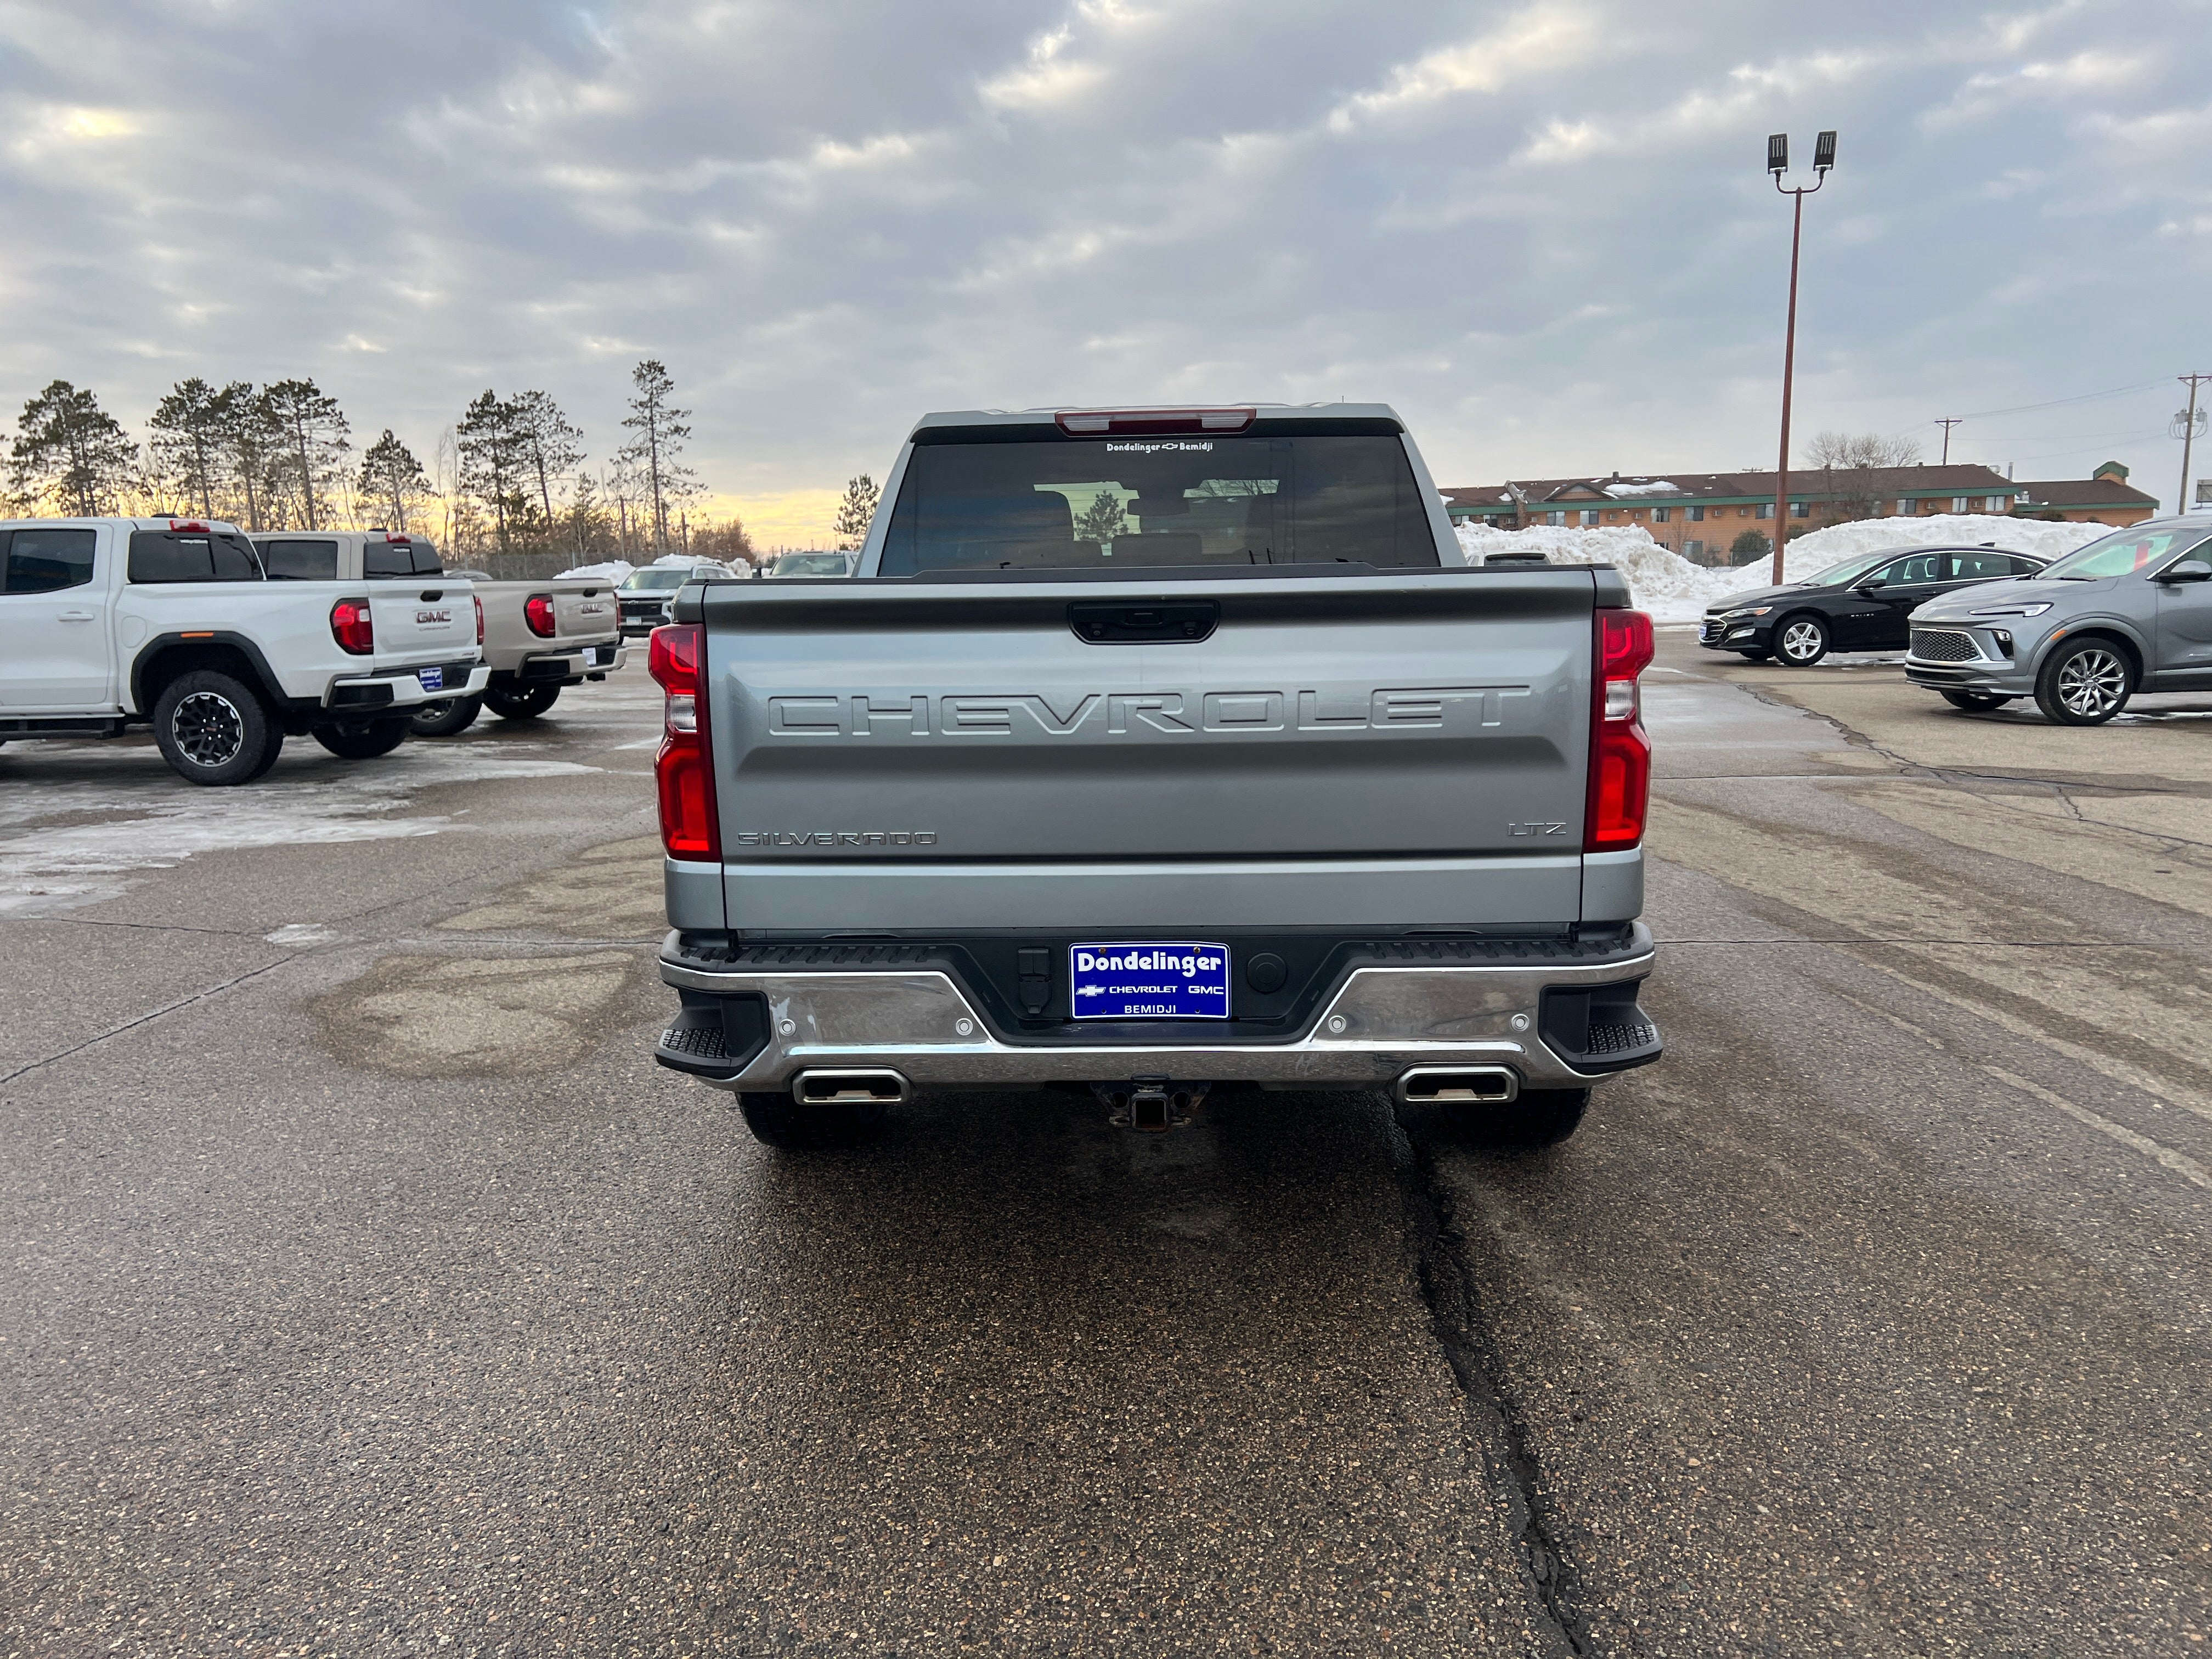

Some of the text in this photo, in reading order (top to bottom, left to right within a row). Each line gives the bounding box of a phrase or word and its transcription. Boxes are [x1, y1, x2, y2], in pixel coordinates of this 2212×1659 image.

[1107, 442, 1213, 454] Dondelinger Bemidji
[416, 611, 451, 624] GMC
[768, 684, 1531, 736] CHEVROLET
[1508, 822, 1567, 836] LTZ
[738, 832, 937, 846] SILVERADO
[1077, 951, 1221, 978] Dondelinger
[1109, 985, 1224, 995] CHEVROLET GMC
[1124, 1005, 1176, 1014] BEMIDJI
